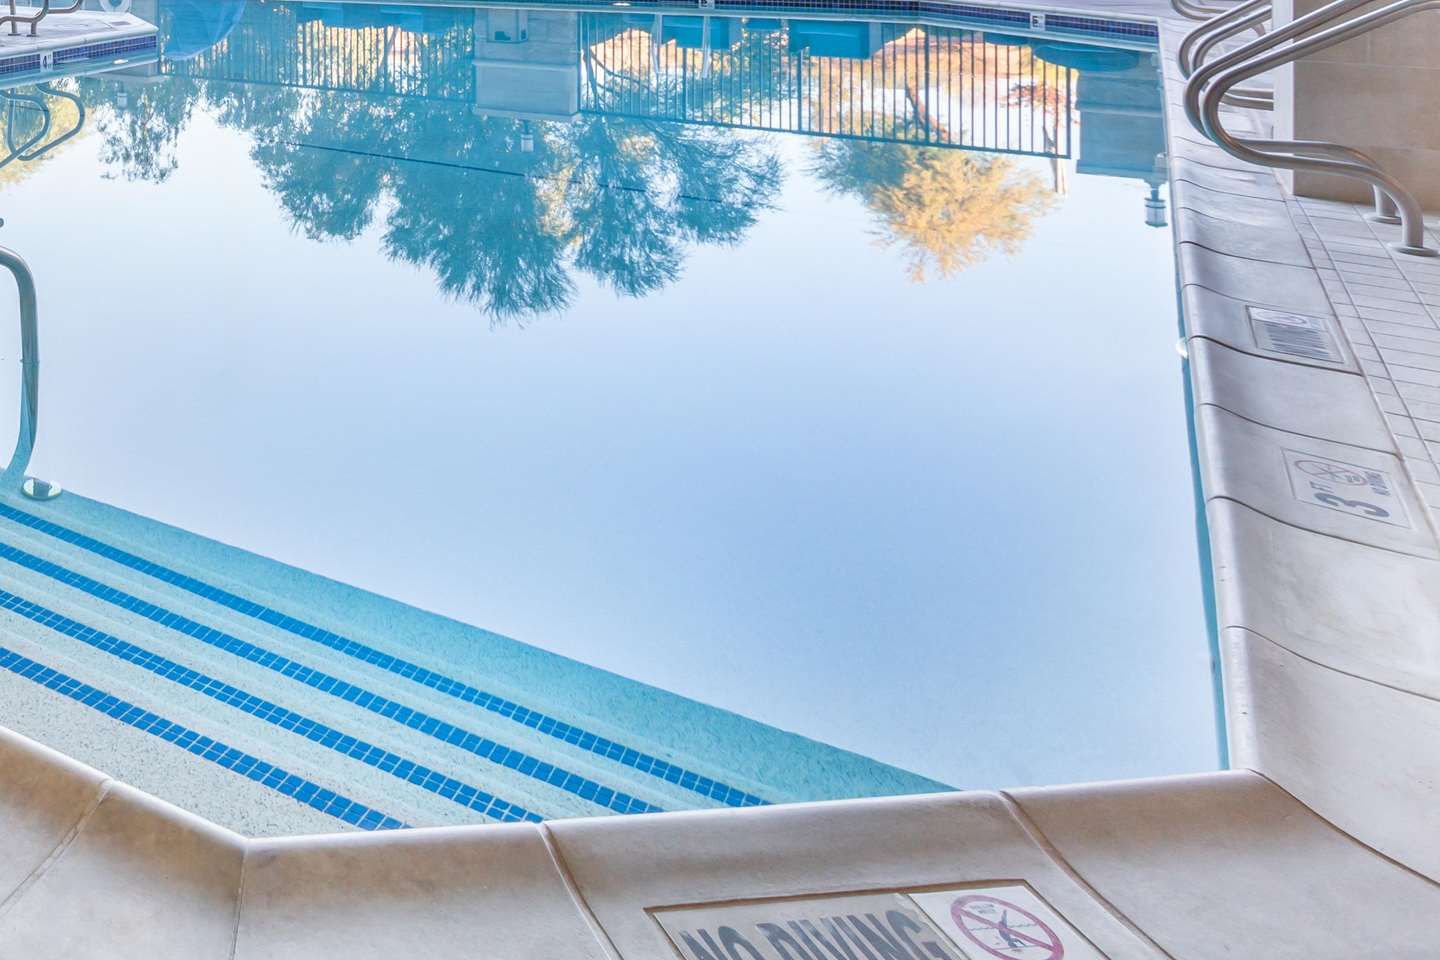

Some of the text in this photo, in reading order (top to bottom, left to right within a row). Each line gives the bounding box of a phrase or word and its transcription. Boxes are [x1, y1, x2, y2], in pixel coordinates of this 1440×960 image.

[1313, 492, 1390, 518] 3
[678, 909, 952, 960] NO DIVING
